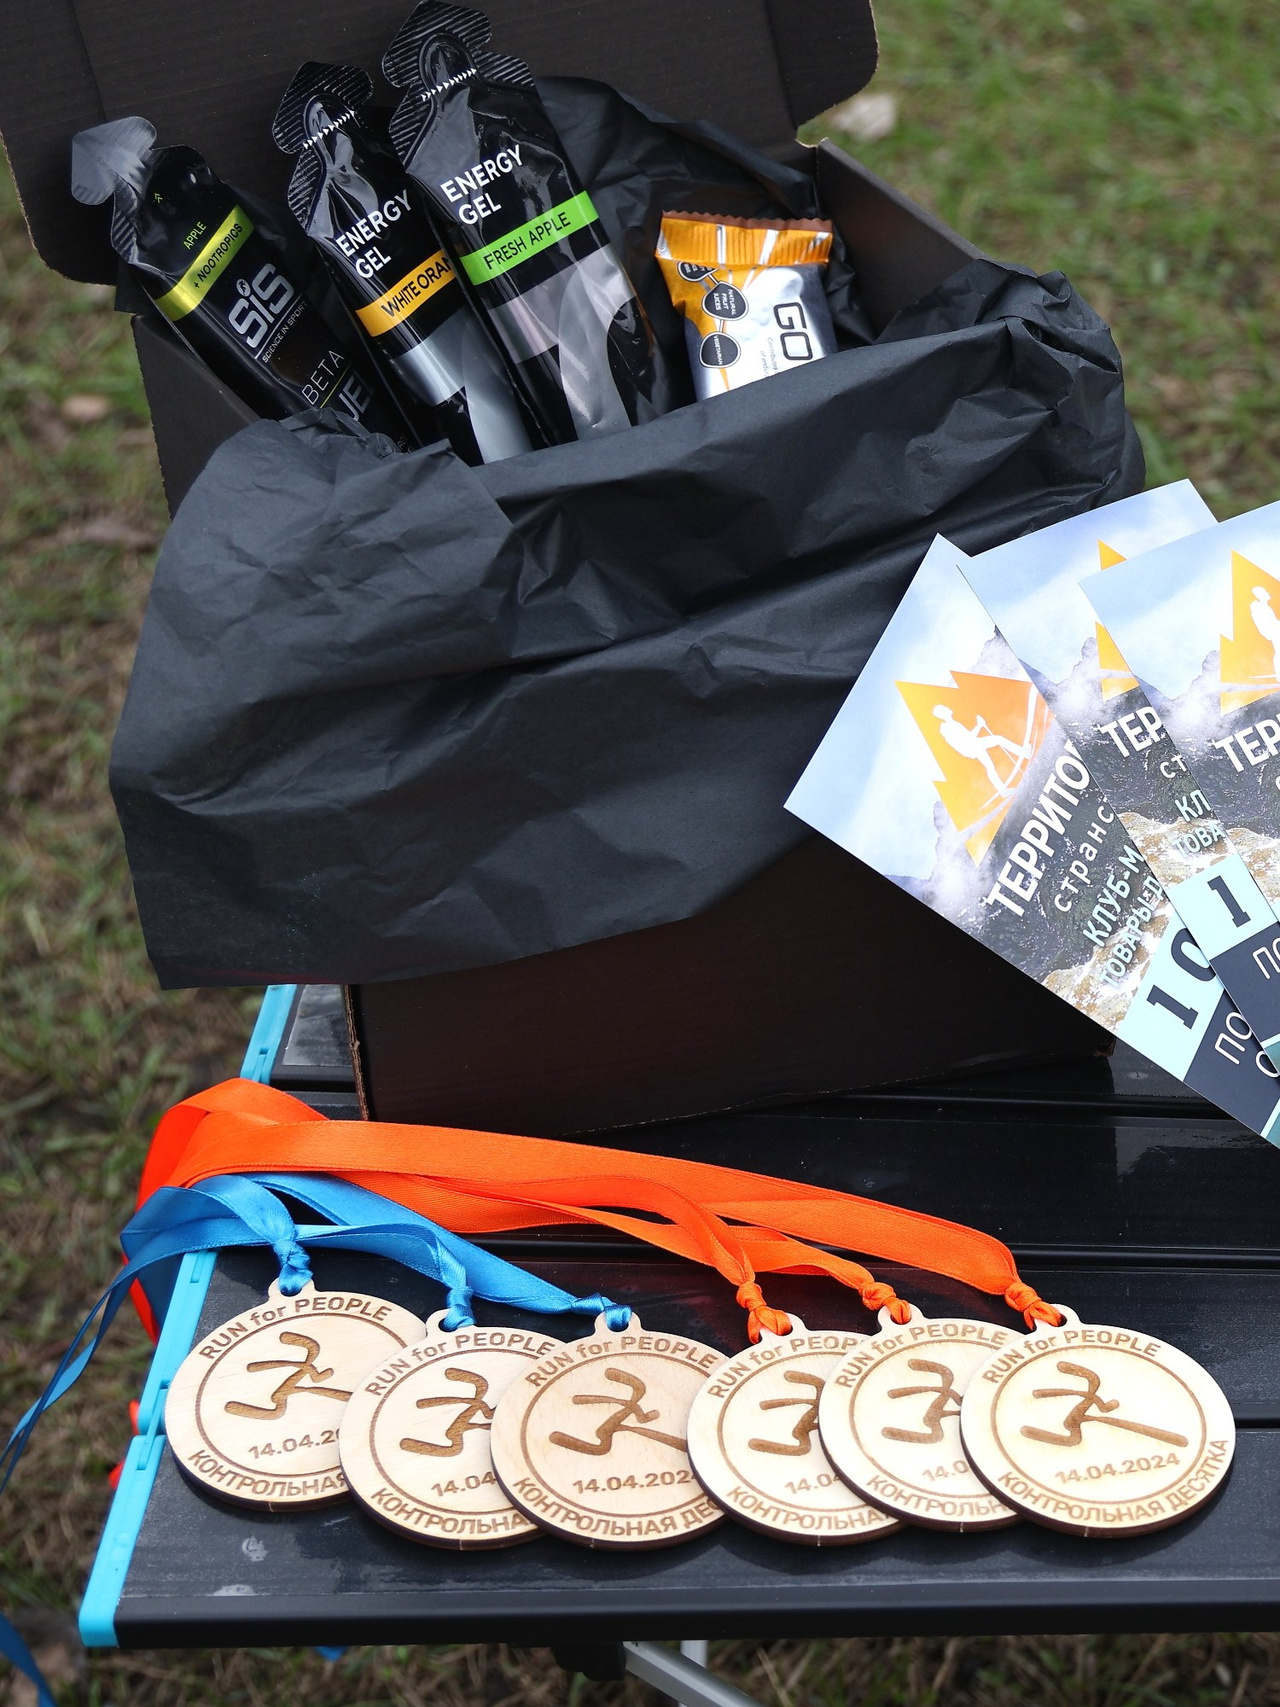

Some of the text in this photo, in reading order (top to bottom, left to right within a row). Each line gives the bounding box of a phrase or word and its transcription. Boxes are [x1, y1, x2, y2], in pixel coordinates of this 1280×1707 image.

[440, 144, 523, 203] ENERGY
[183, 221, 207, 250] APPLE
[335, 189, 412, 257] ENERGY
[458, 192, 502, 225] GEL
[197, 223, 243, 282] NOOTROPICS
[355, 246, 392, 279] GEL
[483, 211, 571, 270] FRESH APPLE
[381, 281, 421, 318] WHITE
[262, 301, 309, 363] SCIENCE SPORT
[773, 302, 814, 360] GO
[302, 350, 345, 405] BETA
[985, 738, 1091, 917] ТЕРРИТО
[1207, 875, 1251, 928] 1
[1099, 896, 1158, 989] ТОВАРЫ
[1146, 984, 1199, 1030] 1
[199, 1296, 392, 1361] RUN for PEOPLE
[835, 1323, 1009, 1389] RUN for PEOPLE
[365, 1331, 556, 1397] RUN for PEOPLE
[524, 1335, 718, 1388] RUN for PEOPLE
[708, 1345, 783, 1398] RUN for
[981, 1329, 1161, 1384] RUN for PEOPLE
[188, 1449, 346, 1498] КОНТРОЛЬНАЯ
[867, 1474, 1012, 1517] КОНТРОЛЬН
[998, 1438, 1229, 1524] КОНТРОЛЬНАЯ ДЕСЯТКА
[1054, 1452, 1180, 1485] 14.04.2024
[371, 1487, 533, 1535] КОНТРОЛЬНА
[512, 1476, 678, 1537] КОНТРОЛЬНАЯ
[725, 1484, 888, 1530] КОНТРОЛЬНА
